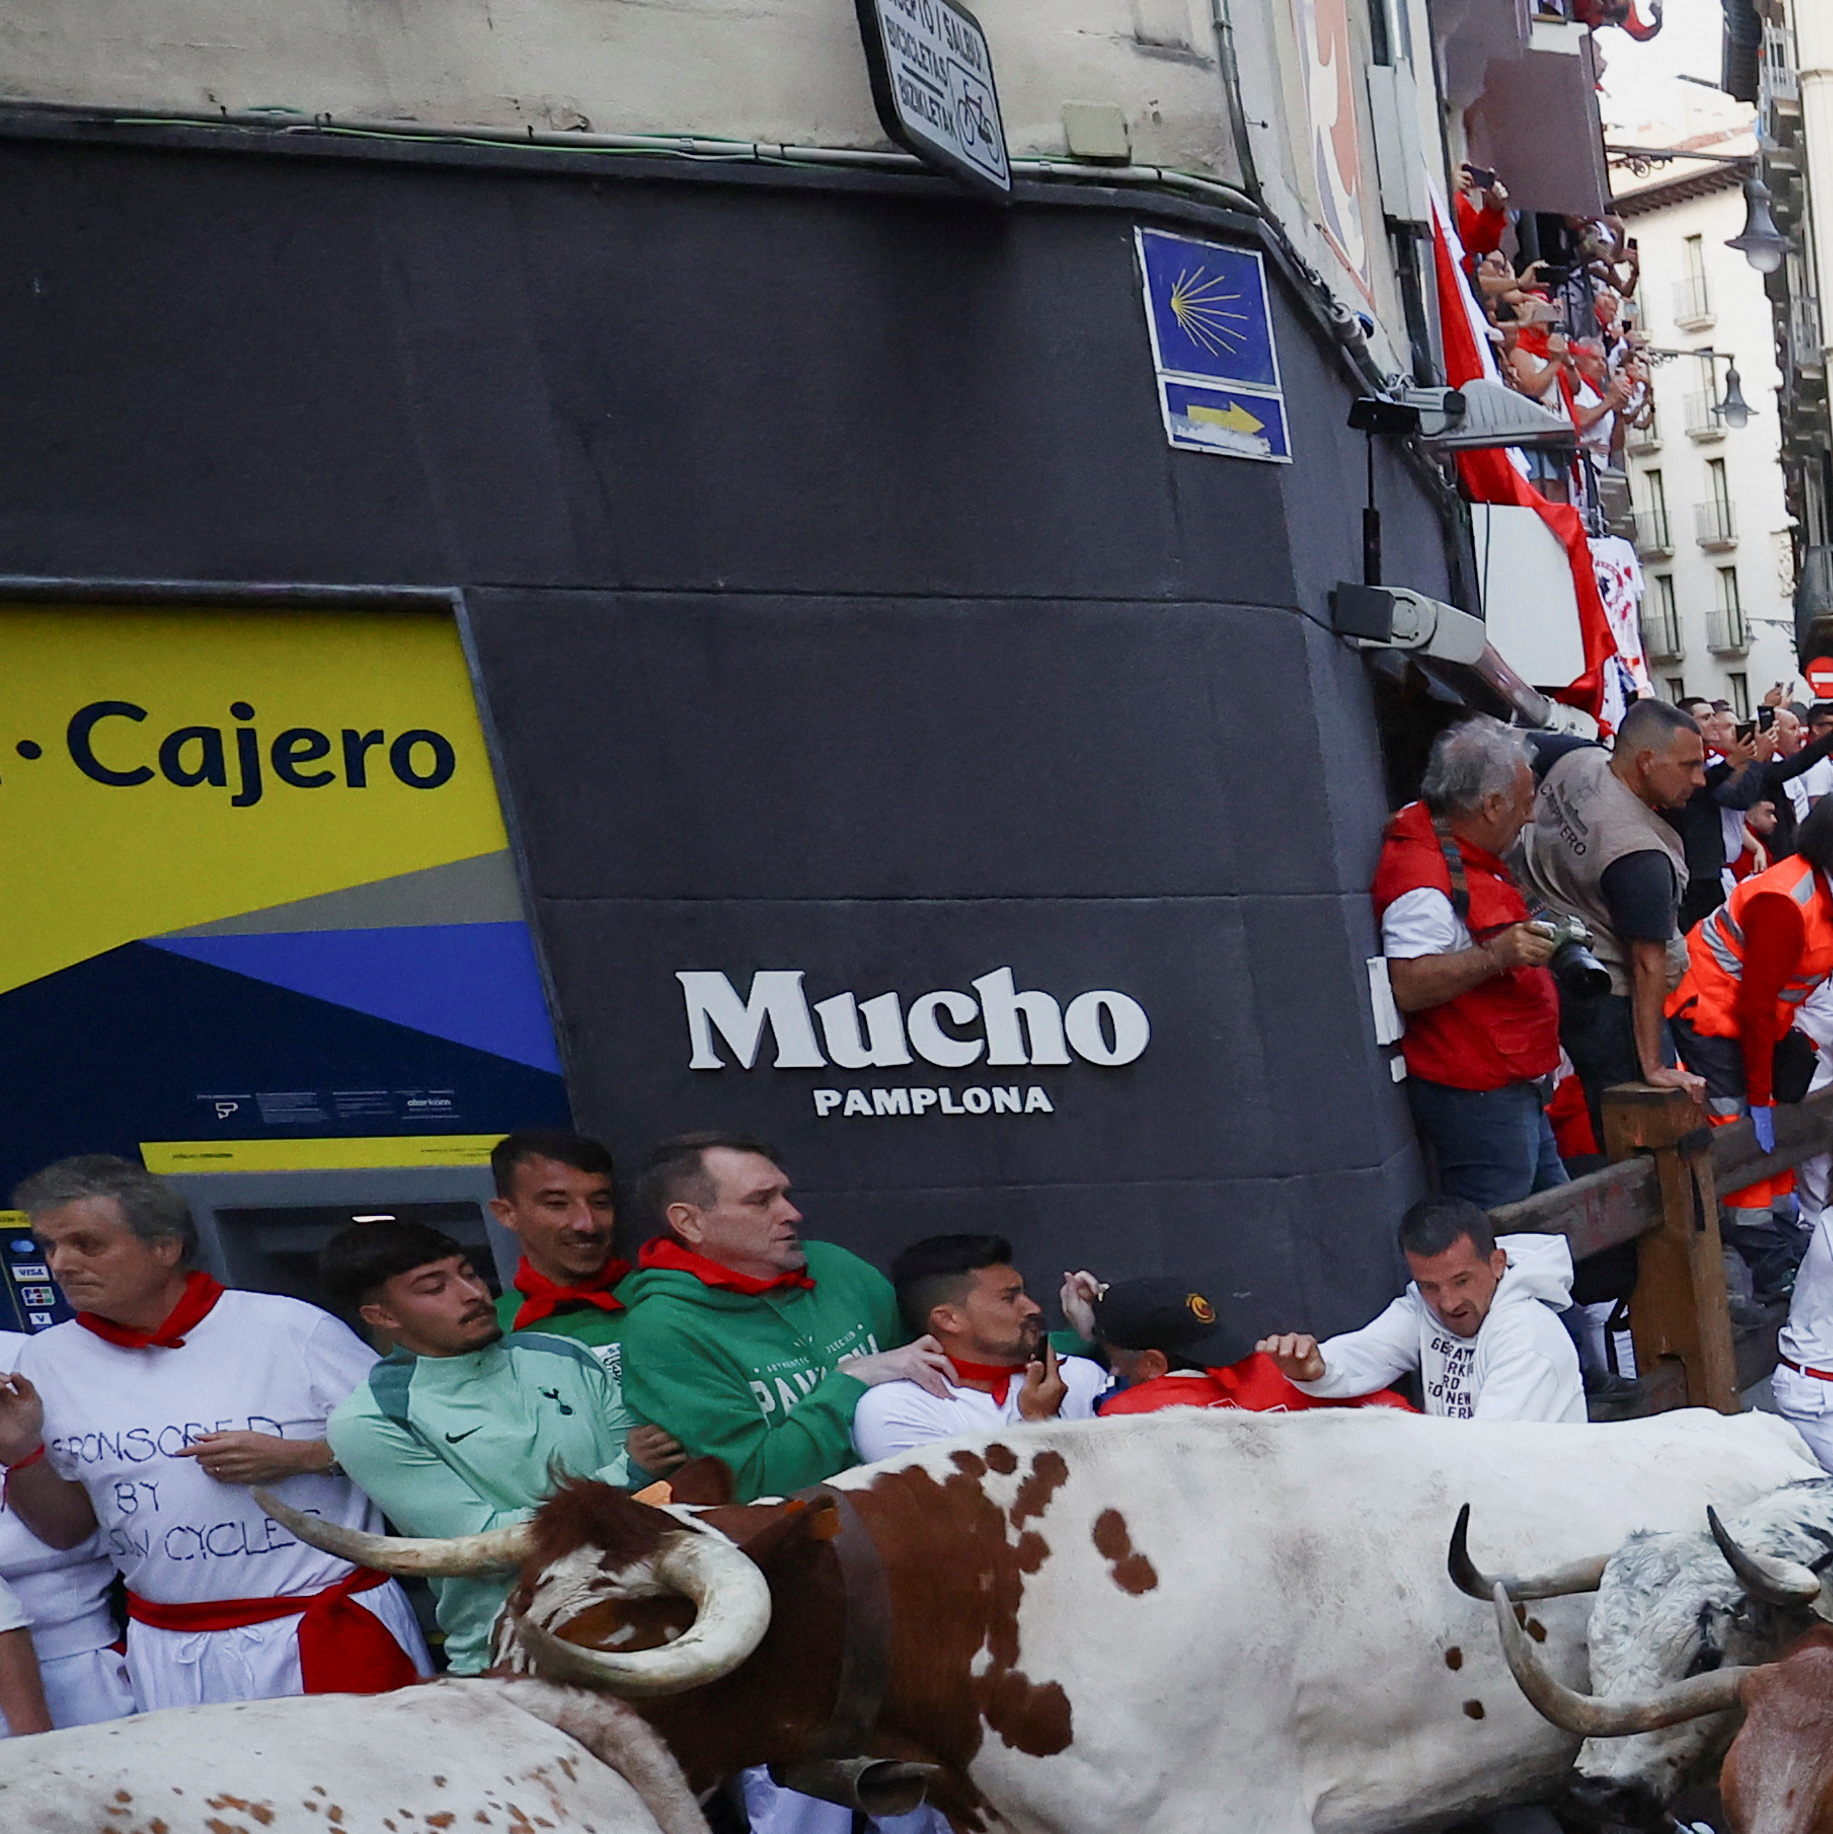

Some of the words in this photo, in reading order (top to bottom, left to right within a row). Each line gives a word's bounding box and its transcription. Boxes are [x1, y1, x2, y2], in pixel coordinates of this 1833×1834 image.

[884, 14, 948, 88] BICICLETAS
[67, 701, 456, 807] Cajero
[675, 966, 1151, 1069] Mucho
[813, 1086, 1055, 1116] PAMPLONA
[18, 1268, 45, 1276] VISA
[114, 1482, 160, 1514] BY
[164, 1509, 321, 1561] CYCLE
